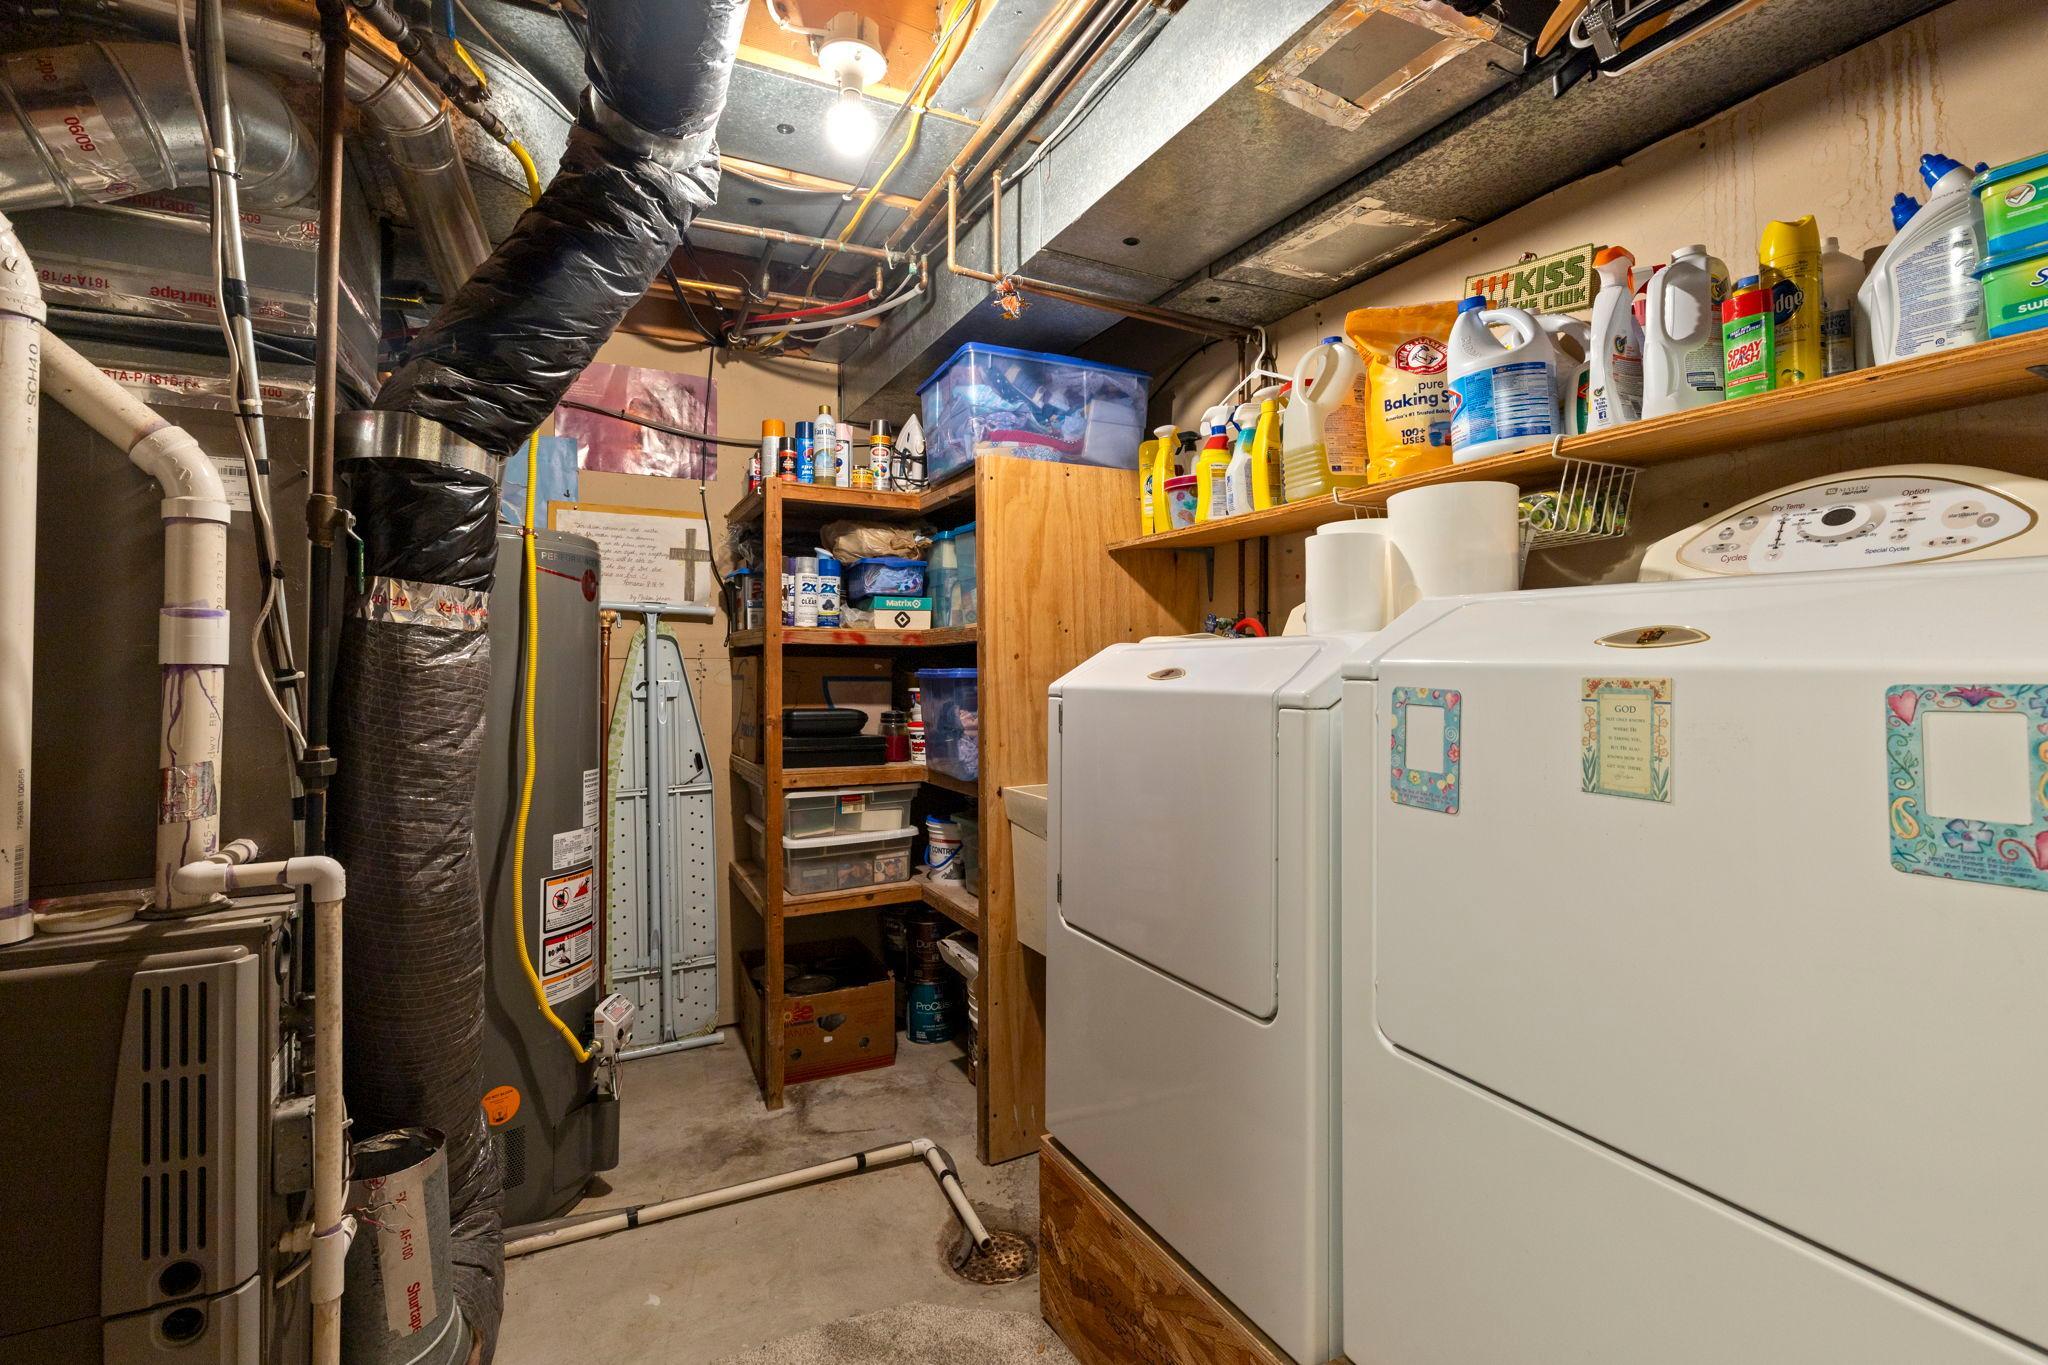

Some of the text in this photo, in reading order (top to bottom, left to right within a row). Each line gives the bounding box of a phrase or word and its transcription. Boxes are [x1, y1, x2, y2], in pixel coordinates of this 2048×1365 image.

[64, 116, 96, 152] 06/09
[1513, 254, 1585, 299] KISS
[1543, 286, 1586, 310] COOK
[1775, 291, 1804, 314] dge
[1727, 338, 1763, 362] SPRAY
[1727, 350, 1760, 372] WASH
[27, 343, 40, 407] SCH40
[1418, 380, 1444, 393] pure
[1384, 392, 1439, 413] Baking
[1401, 428, 1426, 438] 100+
[1402, 436, 1426, 446] USES
[1902, 487, 1931, 497] Option
[1720, 553, 1748, 564] Cycles
[1865, 545, 1910, 554] Special Cycles
[215, 551, 224, 590] 23:37
[886, 599, 913, 607] Matrix
[1614, 704, 1637, 714] GOD
[400, 1228, 414, 1261] AF-100
